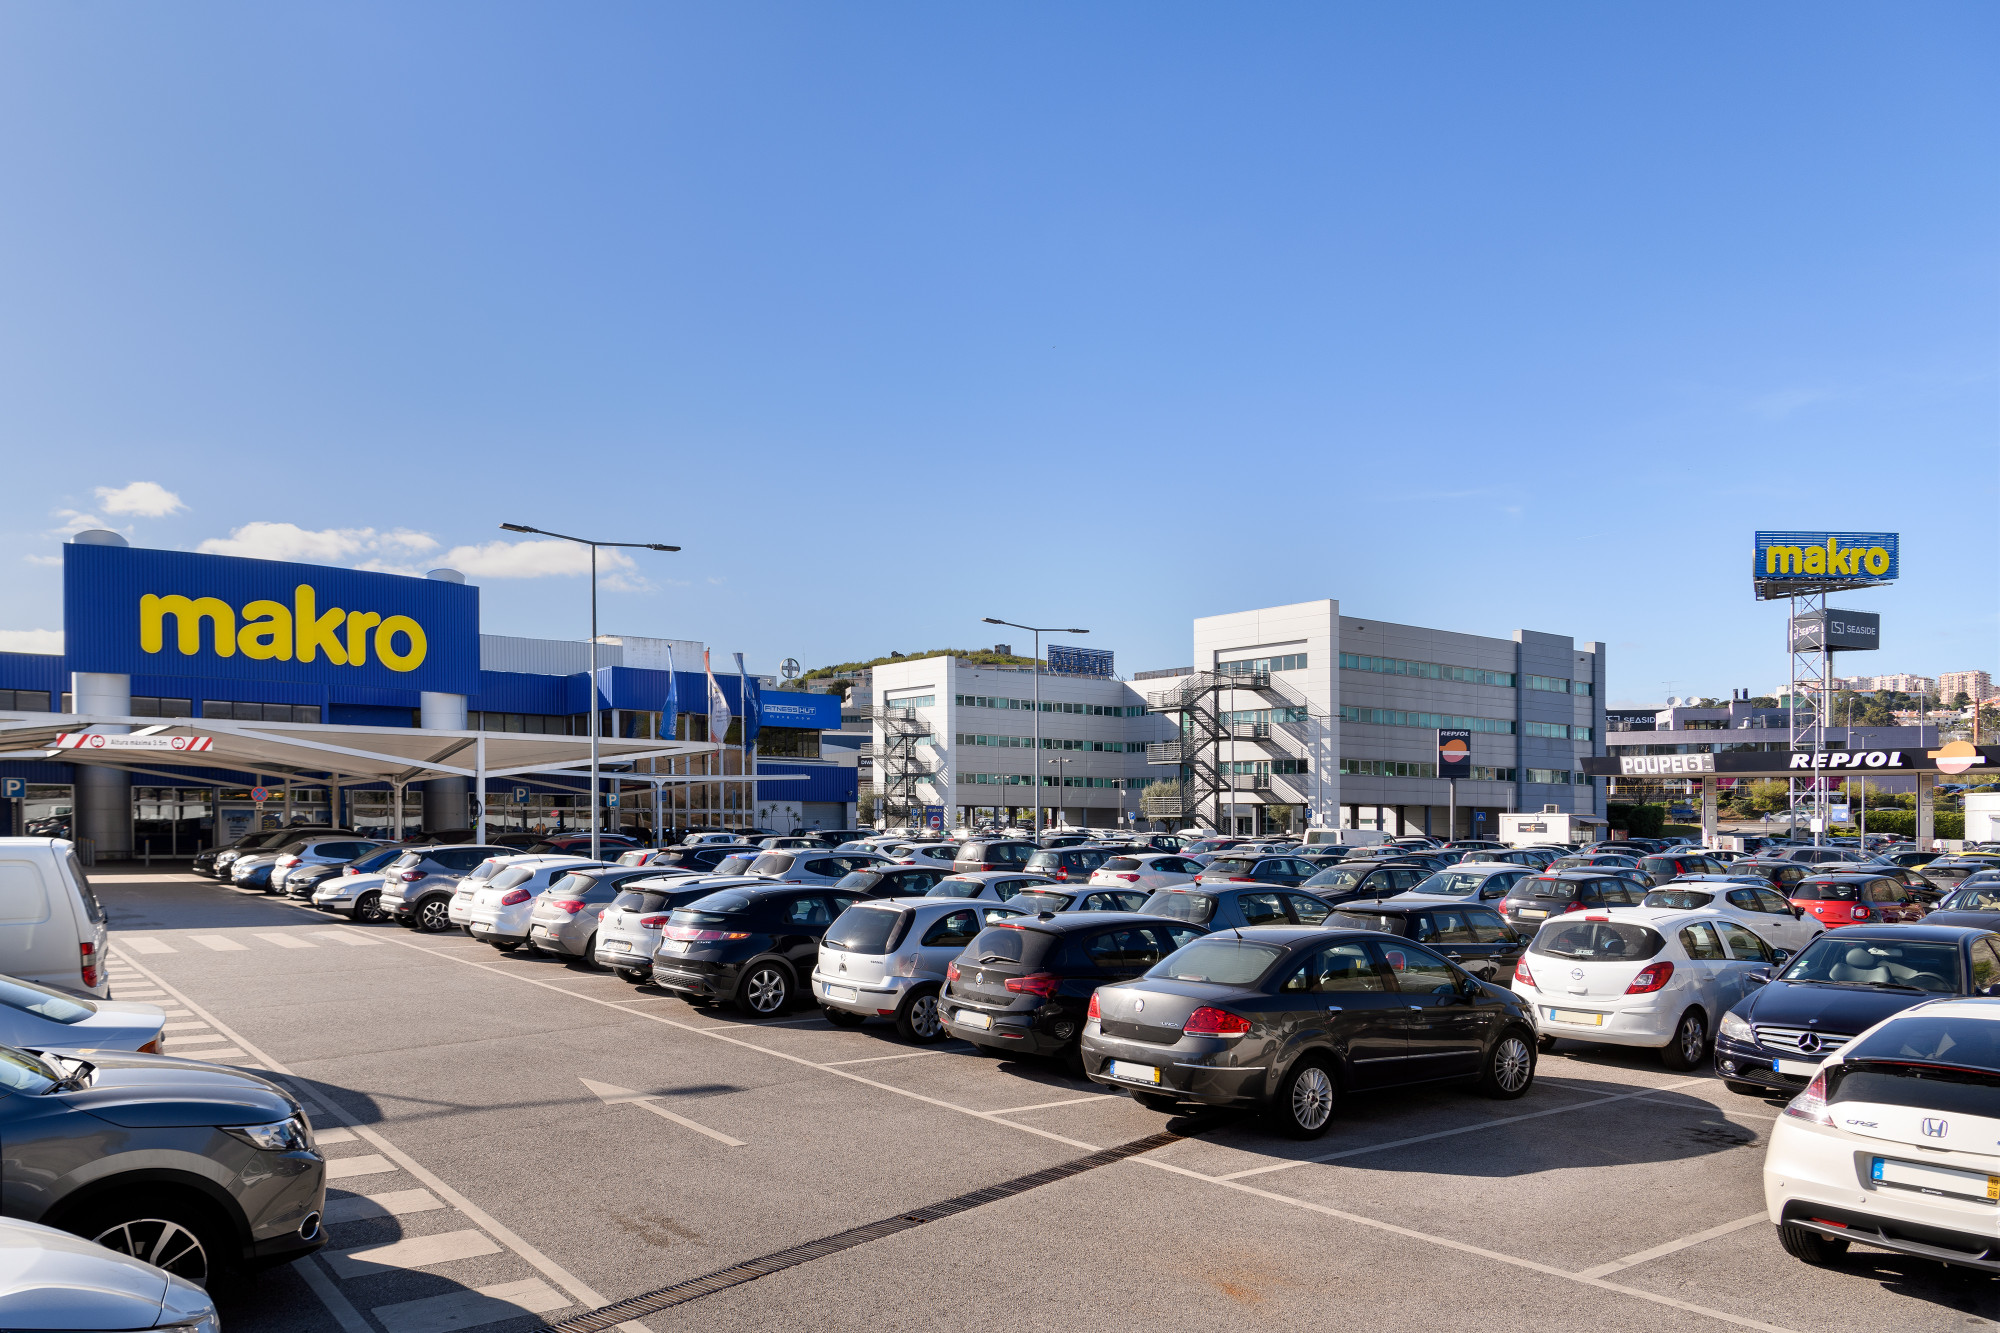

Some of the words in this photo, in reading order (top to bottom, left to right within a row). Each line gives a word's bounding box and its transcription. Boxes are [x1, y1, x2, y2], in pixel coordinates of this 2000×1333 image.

[1766, 537, 1889, 575] makro
[140, 584, 427, 672] makro
[1846, 625, 1876, 635] SEASIDE
[765, 704, 798, 713] FITNESS
[799, 706, 815, 714] HUT
[1622, 757, 1683, 774] POUPE
[1789, 751, 1903, 768] REPSOL
[7, 780, 21, 796] P
[516, 788, 526, 802] P
[609, 795, 617, 805] P
[1991, 1179, 1999, 1187] 10
[1987, 1189, 1998, 1197] 06
